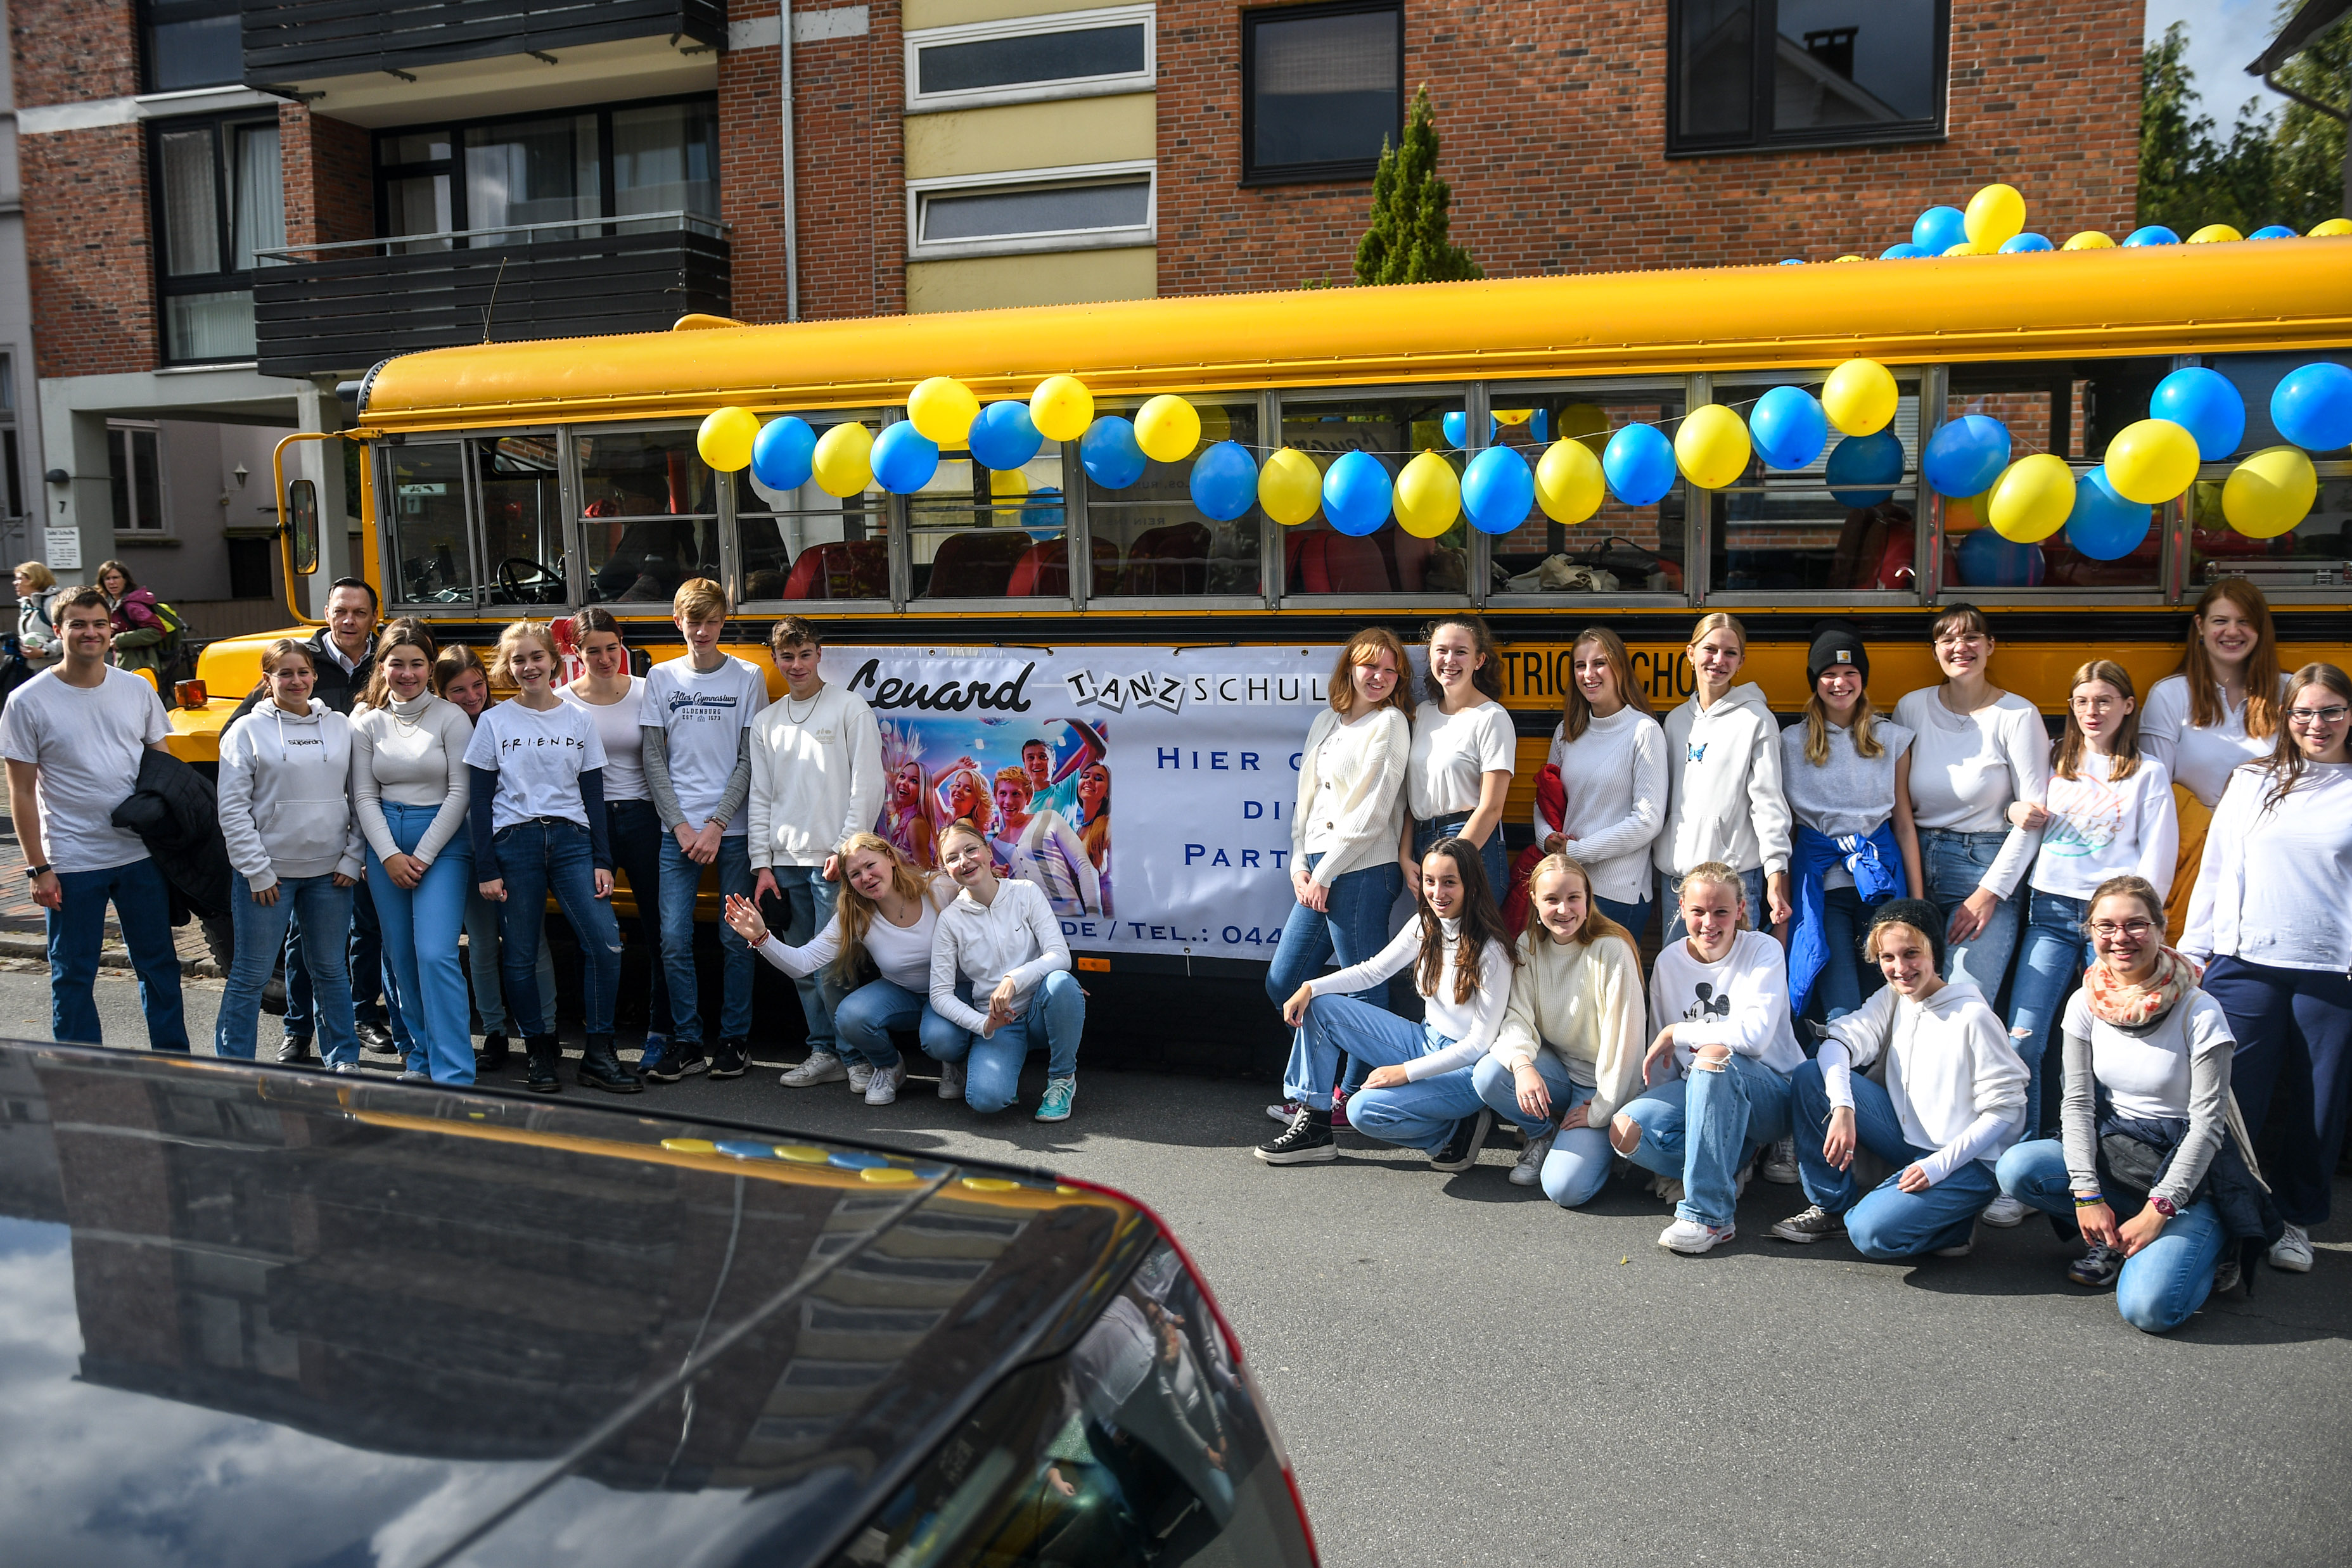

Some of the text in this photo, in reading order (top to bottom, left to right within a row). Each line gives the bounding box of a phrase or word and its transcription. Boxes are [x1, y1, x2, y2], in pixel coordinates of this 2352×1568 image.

[58, 500, 67, 514] 7
[1502, 651, 1696, 697] TRIC CHO
[668, 691, 738, 705] Altes Gymnasium
[1068, 673, 1327, 704] TANZSCHUL
[1157, 747, 1261, 771] HIER
[1243, 800, 1298, 820] DI
[1184, 843, 1288, 869] PART
[1060, 921, 1097, 938] DE
[1222, 925, 1282, 946] 044
